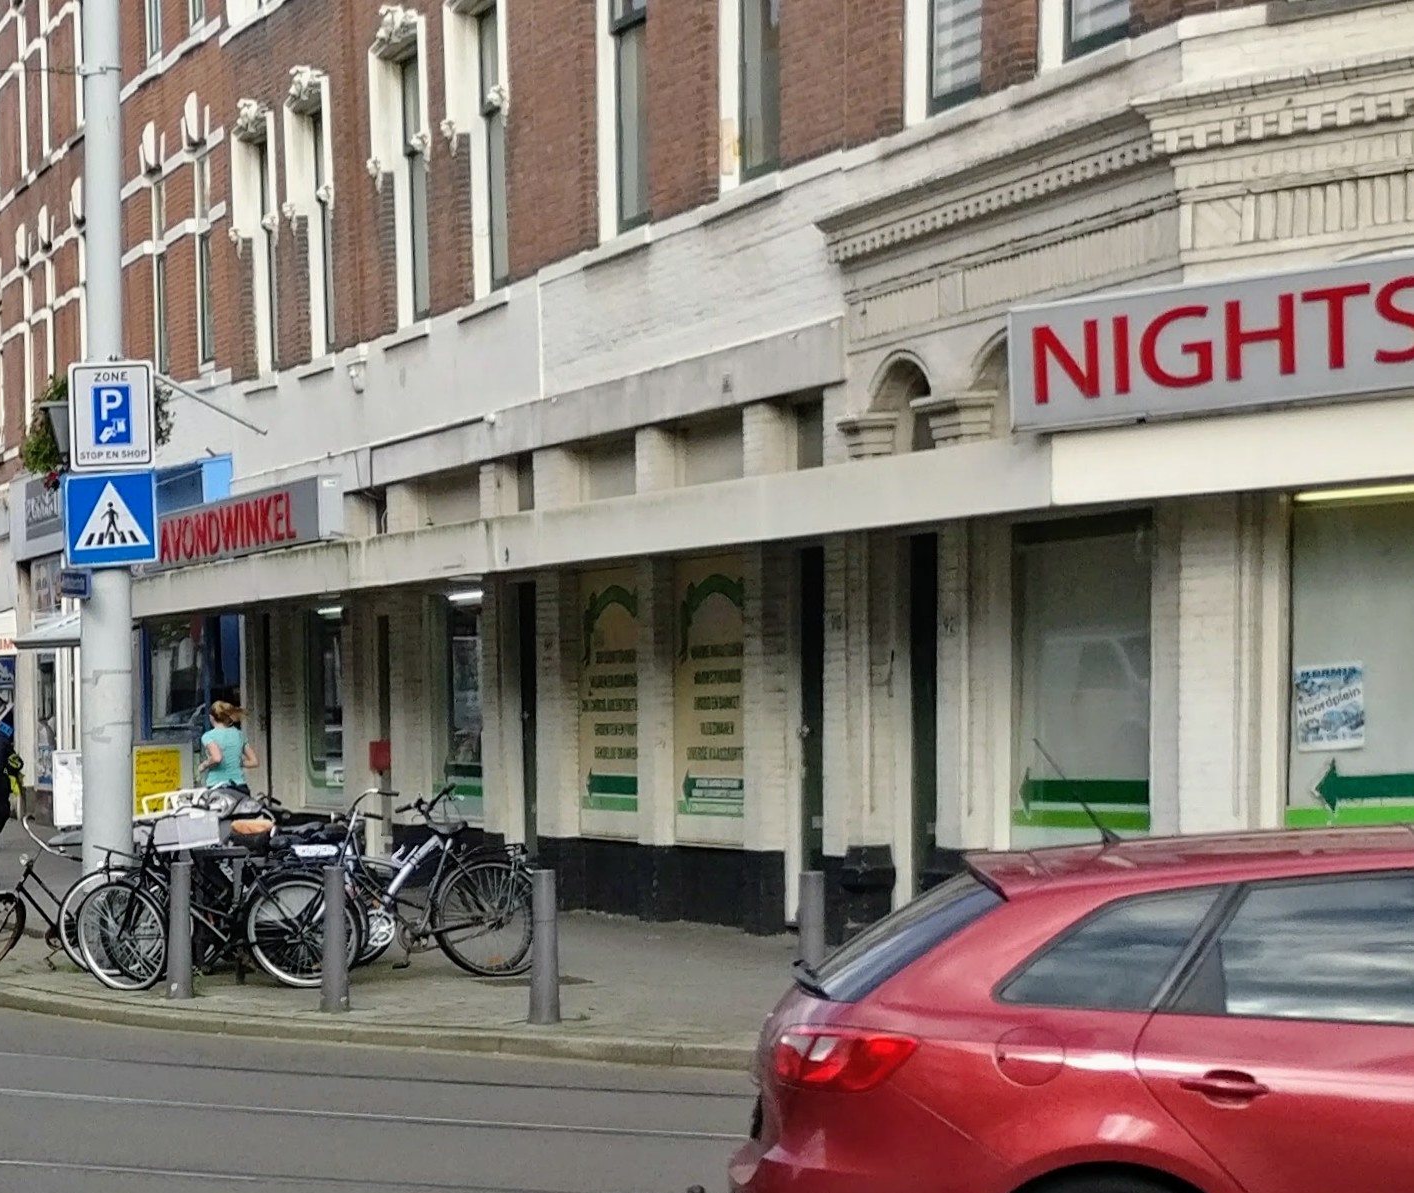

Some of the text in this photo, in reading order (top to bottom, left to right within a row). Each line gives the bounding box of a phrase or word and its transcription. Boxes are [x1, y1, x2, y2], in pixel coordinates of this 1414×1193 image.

[1031, 275, 1414, 406] NIGHTS
[94, 371, 128, 382] ZONE
[100, 389, 123, 421] P
[80, 449, 148, 460] STOP EN SHOP
[160, 491, 297, 565] AVONDWINKEL
